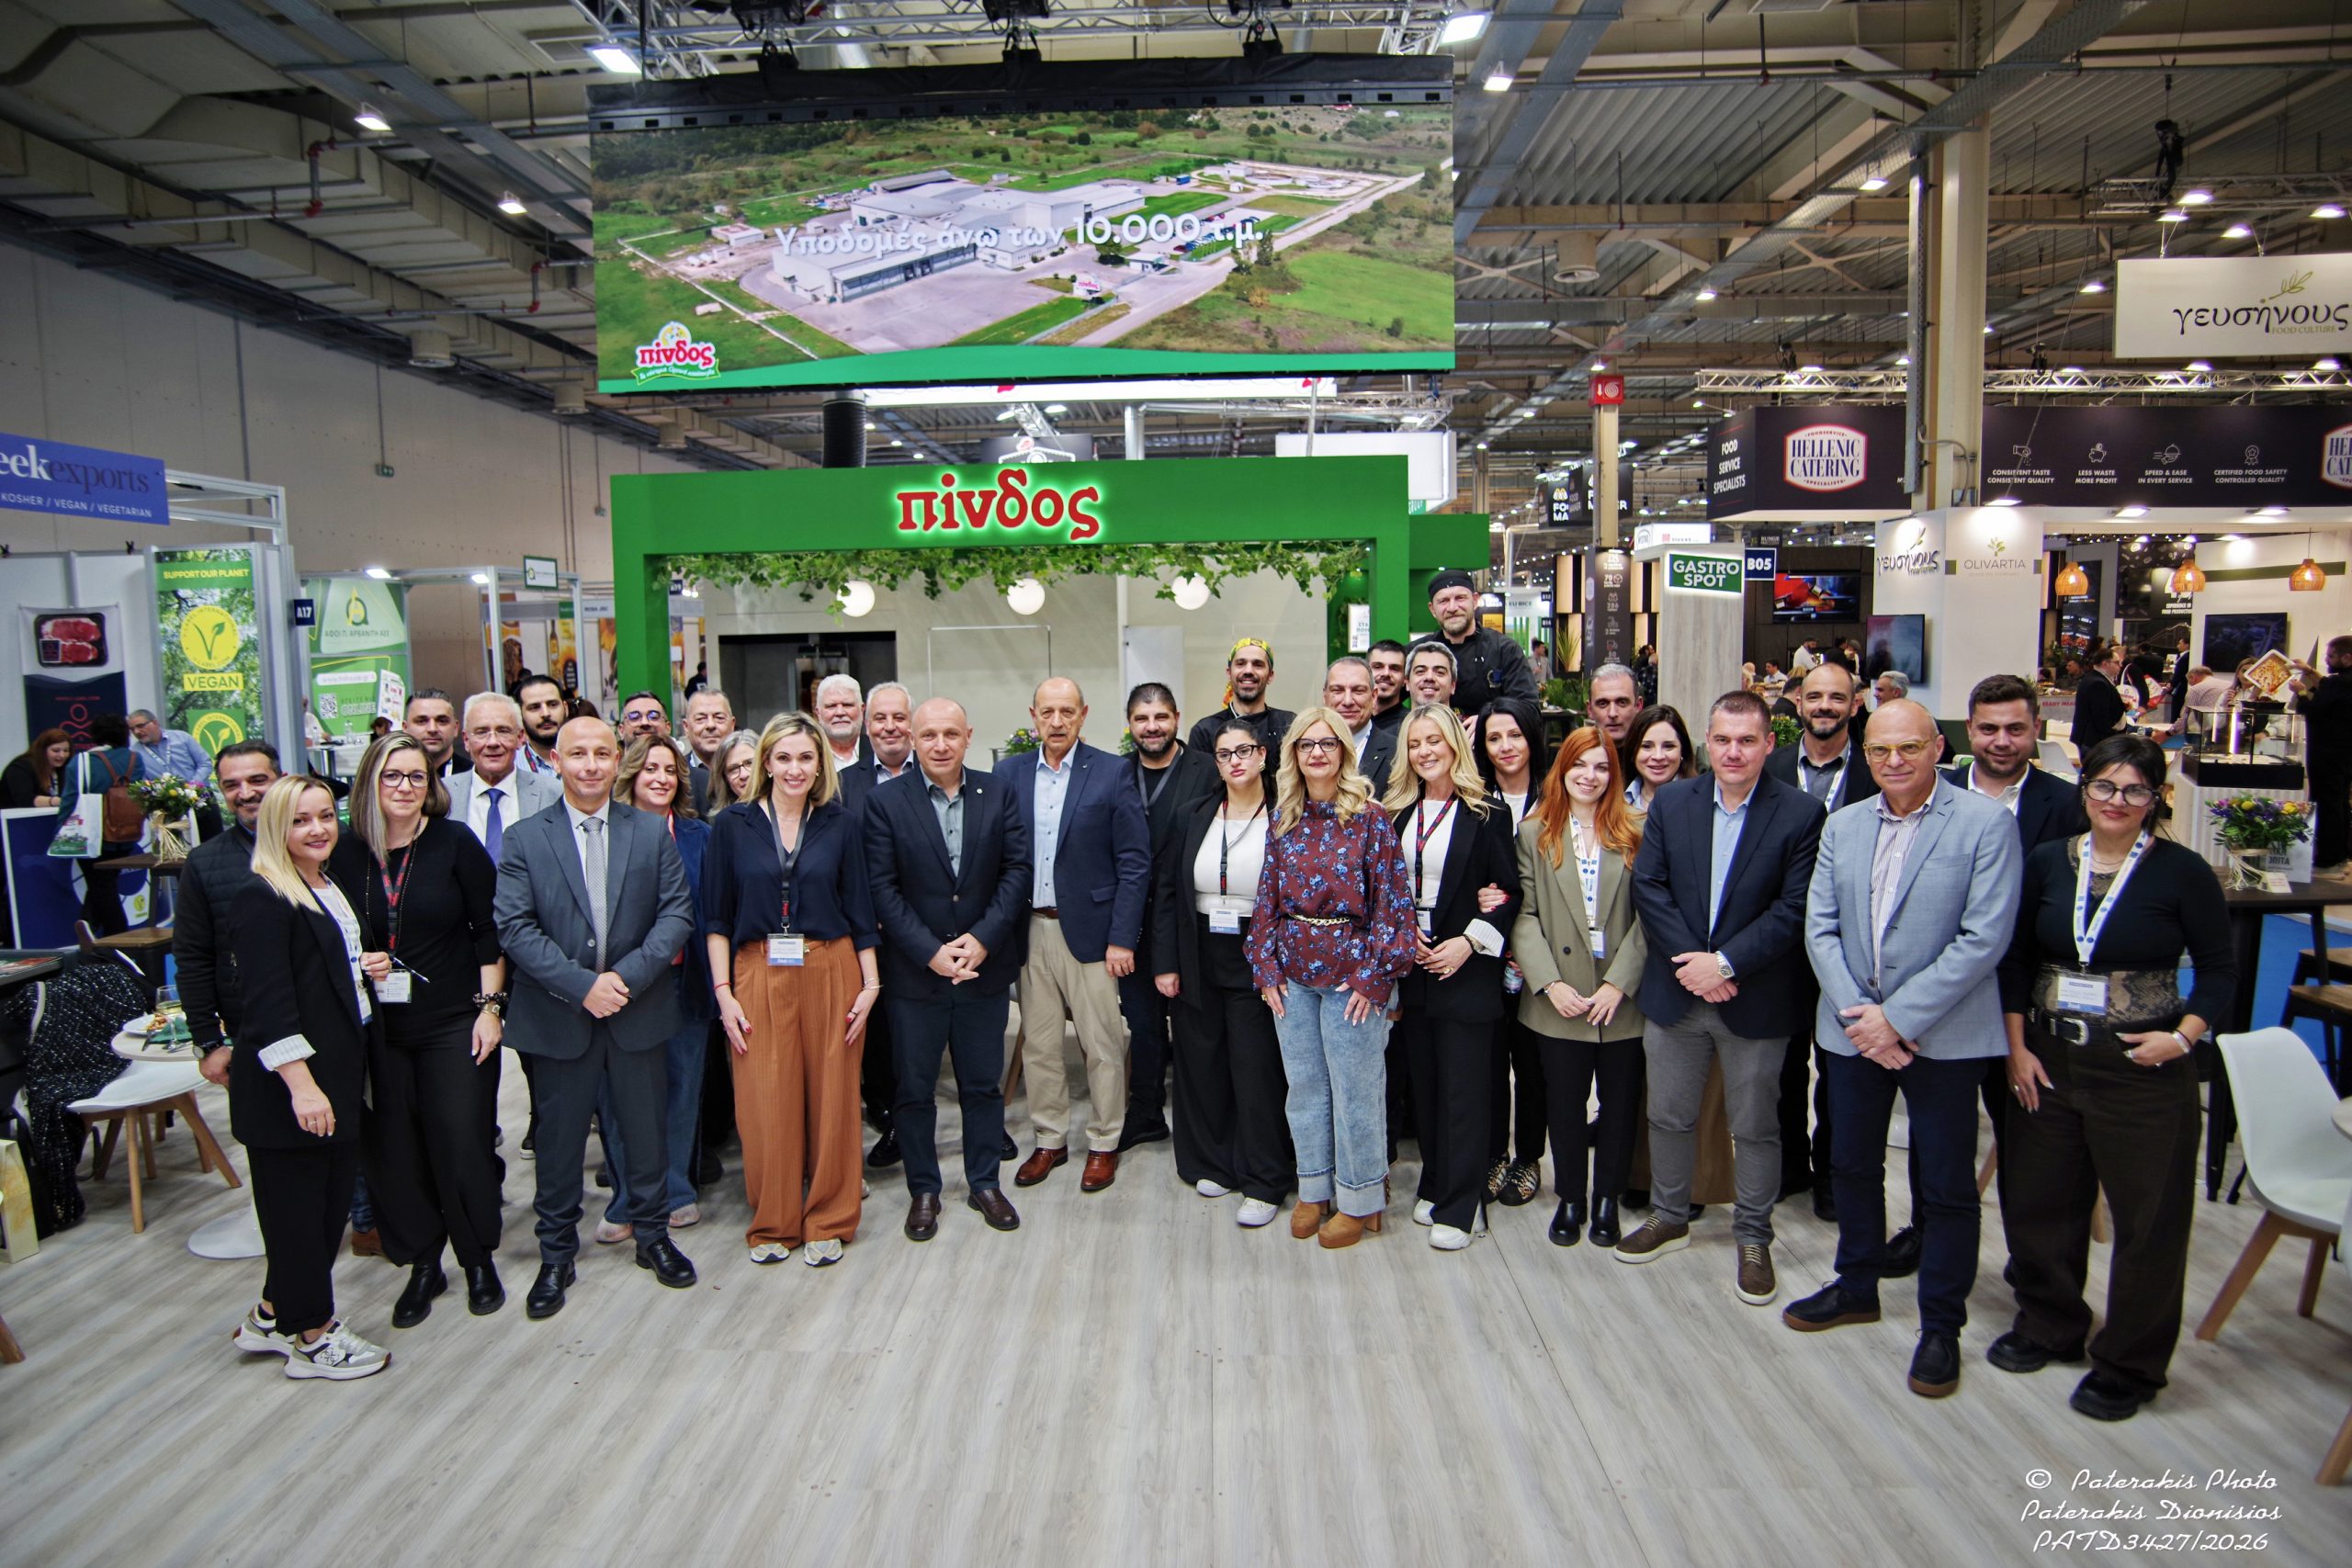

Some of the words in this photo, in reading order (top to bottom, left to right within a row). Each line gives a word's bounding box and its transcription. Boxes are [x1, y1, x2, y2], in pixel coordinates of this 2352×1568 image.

[775, 220, 928, 259] Υποδομές
[937, 221, 1000, 248] άνω
[1008, 227, 1065, 246] των
[1073, 213, 1201, 244] 10.000
[1209, 221, 1263, 248] τ.μ.
[2298, 325, 2336, 333] CULTURE
[639, 340, 713, 367] πίνδος
[1722, 439, 1738, 456] FOOD
[1792, 439, 1860, 457] HELLENIC
[1719, 457, 1740, 476] SERVICE
[1791, 459, 1860, 478] CATERING
[1713, 474, 1746, 494] SPECIALISTS
[1, 492, 44, 506] KOSHER
[54, 498, 87, 511] VEGAN
[97, 503, 153, 518] VEGETARIAN
[897, 468, 1100, 540] πίνδος
[1673, 559, 1740, 575] GASTRO
[1747, 558, 1772, 571] B05
[1964, 559, 2026, 570] OLIVARTIA
[164, 570, 200, 579] SUPPORT
[200, 570, 219, 578] OUR
[219, 569, 249, 578] PLANET
[1683, 574, 1726, 588] SPOT
[296, 606, 312, 618] A17
[187, 675, 239, 688] VEGAN
